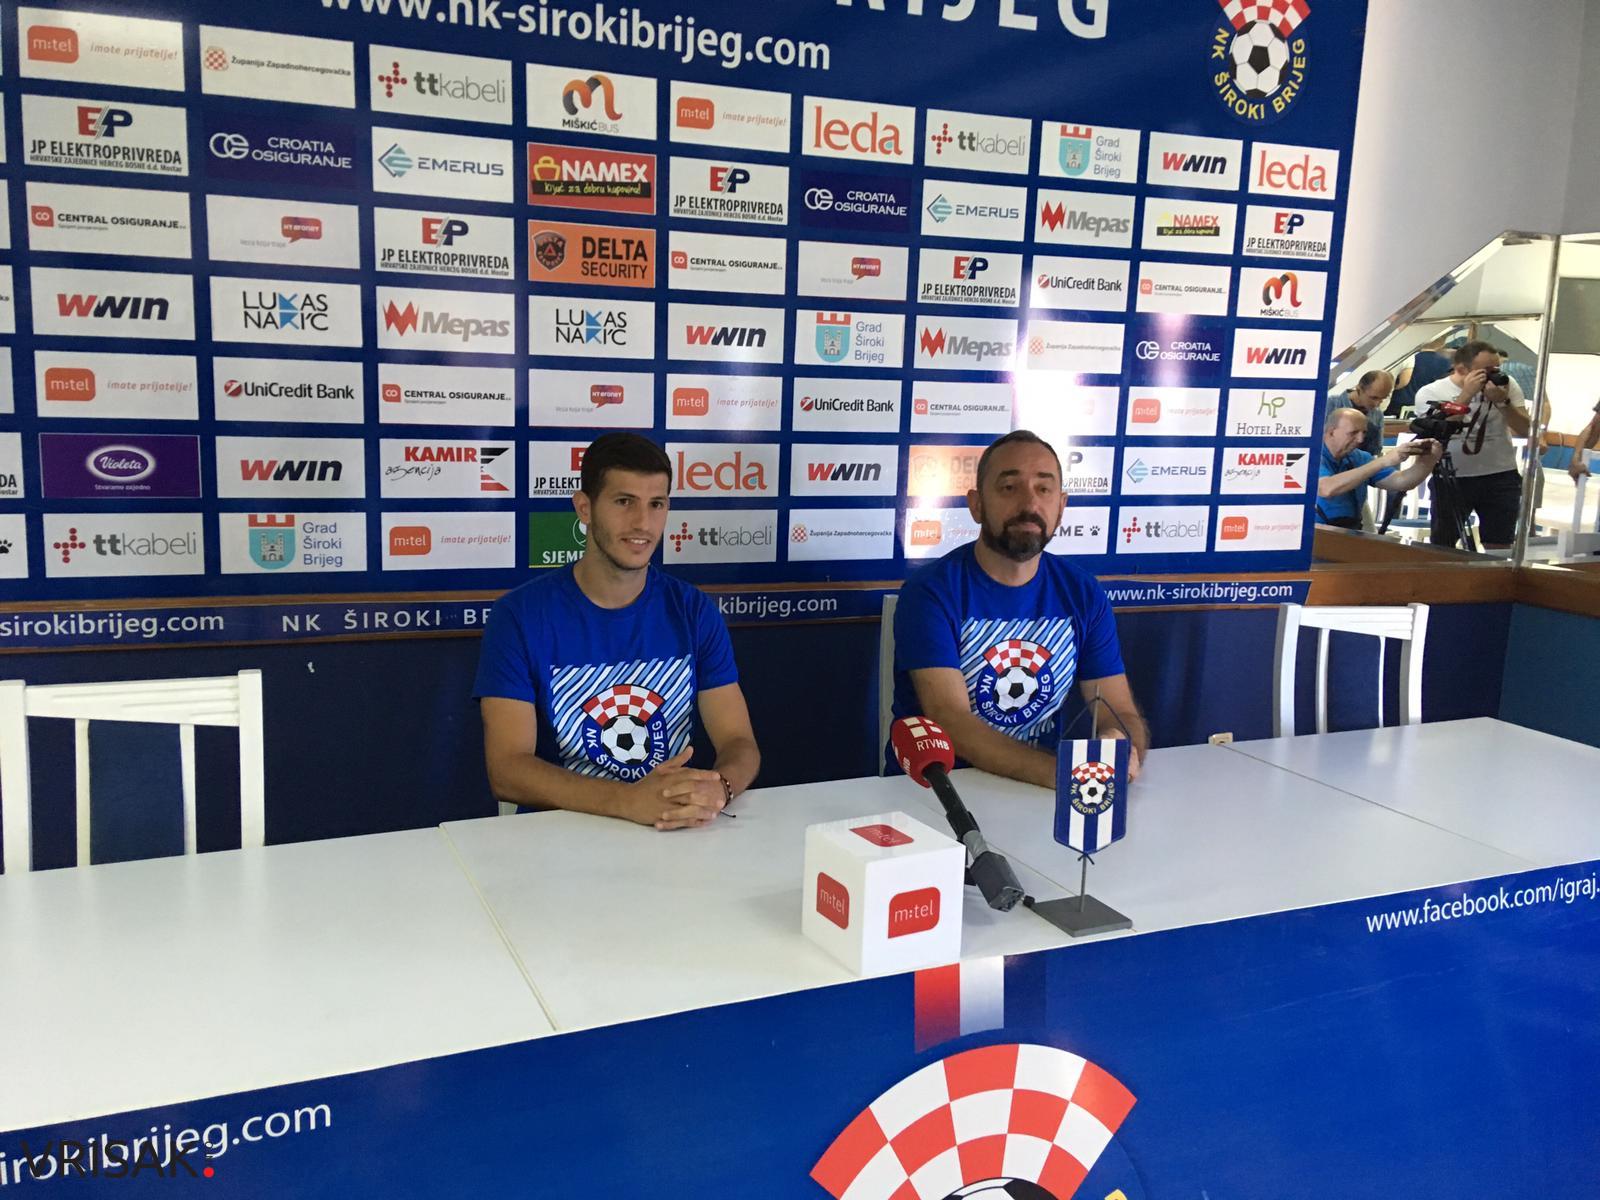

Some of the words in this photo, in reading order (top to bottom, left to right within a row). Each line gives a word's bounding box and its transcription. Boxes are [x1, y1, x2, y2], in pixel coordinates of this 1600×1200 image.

[32, 37, 73, 54] m:tel
[1212, 28, 1230, 60] NK
[231, 55, 265, 69] Županija
[1271, 38, 1306, 114] BRIJEG
[414, 71, 506, 103] ttkabeli
[1213, 72, 1265, 119] ŠIROKI
[680, 107, 709, 122] m:tel
[813, 105, 903, 156] leda
[267, 136, 335, 154] CROATIA
[957, 130, 1027, 157] ttkabeli
[1095, 135, 1120, 148] Grad
[30, 139, 46, 154] JP
[51, 141, 182, 164] ELEKTROPRIVREDA
[251, 149, 352, 169] OSIGURANJE
[1095, 148, 1122, 163] Široki
[418, 157, 504, 176] EMERUS
[562, 159, 648, 183] NAMEX
[1093, 165, 1121, 179] Brijeg
[1257, 150, 1328, 192] leda
[674, 195, 686, 207] JP
[689, 196, 783, 215] ELEKTROPRIVREDA
[847, 190, 896, 204] CROATIA
[834, 201, 907, 216] OSIGURANJE
[956, 204, 1019, 219] EMERUS
[58, 213, 108, 224] CENTRAL
[1066, 210, 1130, 237] Mepas
[1173, 214, 1218, 227] NAMEX
[581, 236, 648, 261] DELTA
[1247, 237, 1256, 248] JP
[1257, 237, 1327, 252] ELEKTROPRIVREDA
[381, 248, 394, 261] JP
[398, 250, 509, 269] ELEKTROPRIVREDA
[690, 257, 726, 268] CENTRAL
[581, 261, 648, 279] SECURITY
[922, 283, 932, 294] JP
[935, 284, 1016, 298] ELEKTROPRIVREDA
[1050, 276, 1095, 290] UniCredit
[1097, 278, 1122, 292] Bank
[1154, 284, 1183, 292] CENTRAL
[421, 310, 510, 342] Mepas
[855, 321, 882, 333] Grad
[855, 335, 885, 348] Široki
[947, 336, 1013, 361] Mepas
[1171, 341, 1211, 351] CROATIA
[854, 350, 885, 364] Brijeg
[1160, 351, 1220, 362] OSIGURANJE
[50, 376, 89, 392] m:tel
[107, 380, 137, 391] imate
[139, 380, 192, 393] prijatelje!
[244, 382, 313, 398] UniCredit
[317, 384, 354, 400] Bank
[404, 390, 447, 399] CENTRAL
[676, 396, 705, 408] m:tel
[814, 398, 864, 412] UniCredit
[866, 400, 894, 413] Bank
[404, 446, 478, 462] KAMIR
[1238, 453, 1284, 466] KAMIR
[100, 456, 143, 470] Violeta
[676, 451, 768, 491] leda
[1151, 466, 1207, 476] EMERUS
[385, 464, 442, 482] agencija
[534, 477, 546, 489] JP
[1063, 477, 1108, 487] PRIVREDA
[302, 522, 337, 534] Grad
[698, 525, 772, 546] ttkabeli
[809, 530, 833, 538] Županija
[1145, 520, 1205, 538] ttkabeli
[92, 532, 197, 556] ttkabeli
[303, 536, 342, 550] Široki
[394, 535, 426, 547] m:tel
[440, 535, 466, 544] imate
[467, 534, 512, 546] prijatelje!
[303, 554, 343, 568] Brijeg
[1104, 583, 1293, 603] www.nk-sirokibrijeg.com
[718, 596, 838, 617] kibrijeg.com
[0, 612, 224, 639] sirokibrijeg.com
[282, 614, 321, 632] NK
[344, 608, 442, 630] ŠIROKI
[979, 674, 994, 694] NK
[1023, 673, 1050, 718] BRIJEG
[981, 700, 1018, 724] ŠIROKI
[586, 728, 597, 749] NK
[596, 754, 647, 780] ŠIROKI
[649, 720, 664, 768] BRIJEG
[916, 739, 950, 751] RTVHB
[820, 888, 845, 915] m:tel
[894, 901, 934, 923] m:tel
